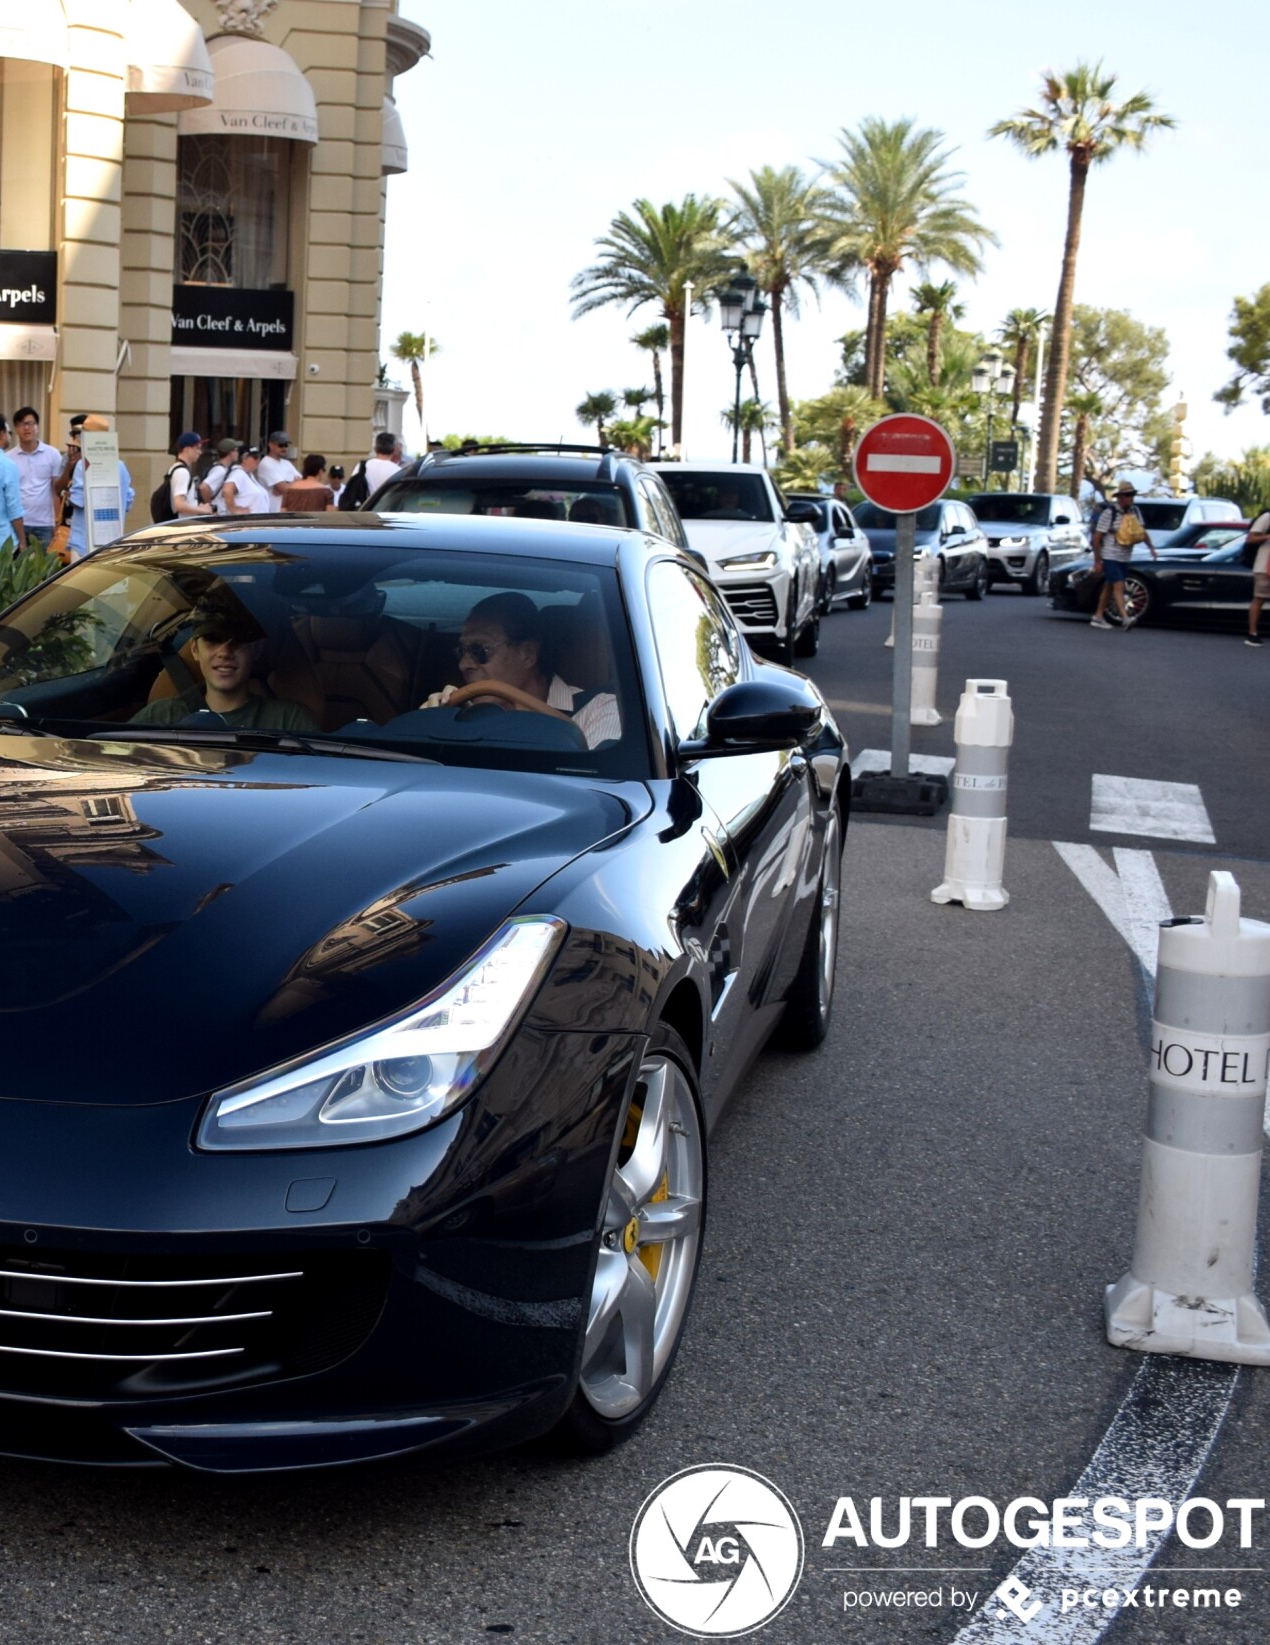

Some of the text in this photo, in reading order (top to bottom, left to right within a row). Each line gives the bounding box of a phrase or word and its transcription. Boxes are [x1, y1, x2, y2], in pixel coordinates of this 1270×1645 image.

[220, 114, 248, 128] Van
[252, 116, 287, 131] Cleef
[171, 312, 286, 338] Van Cleef & Arpels
